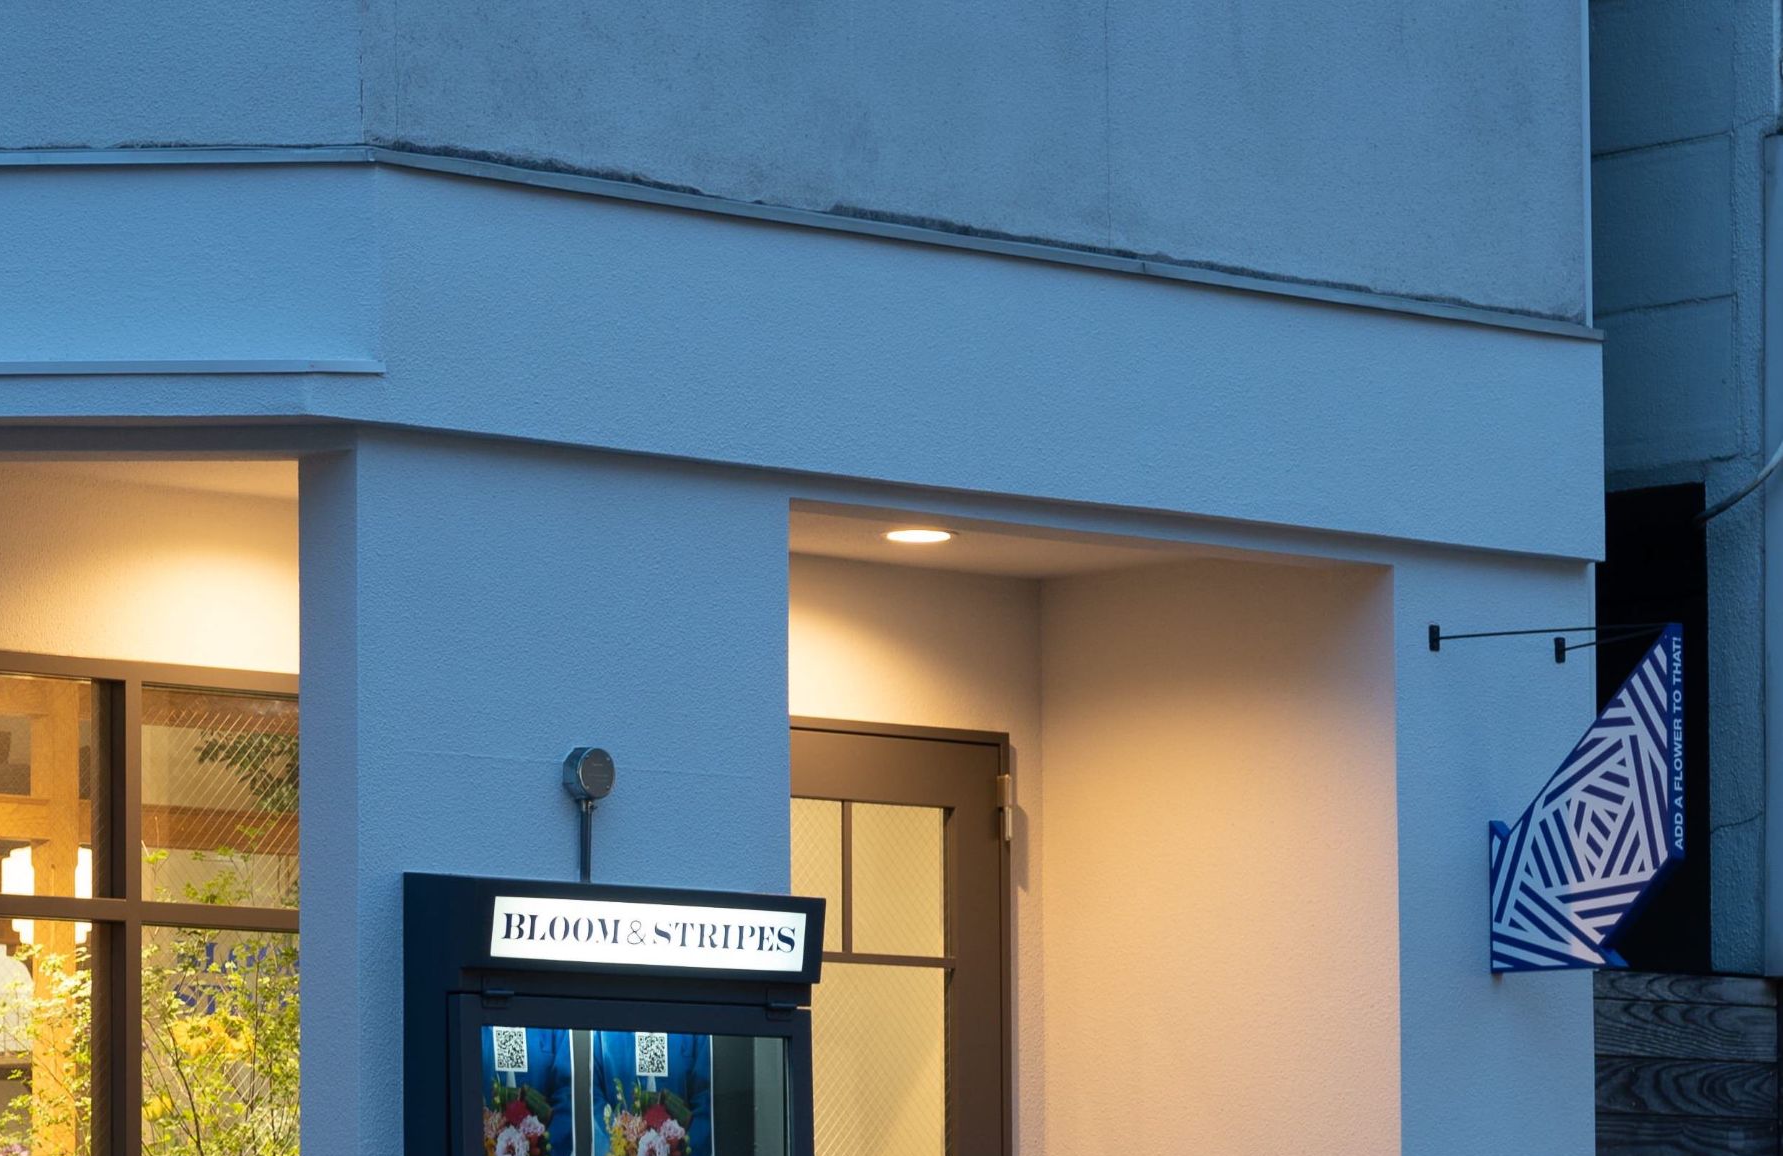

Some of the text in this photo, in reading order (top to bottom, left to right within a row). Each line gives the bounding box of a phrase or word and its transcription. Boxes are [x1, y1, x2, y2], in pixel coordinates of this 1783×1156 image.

[1672, 636, 1683, 850] ADD A FLOWER TO THAT!
